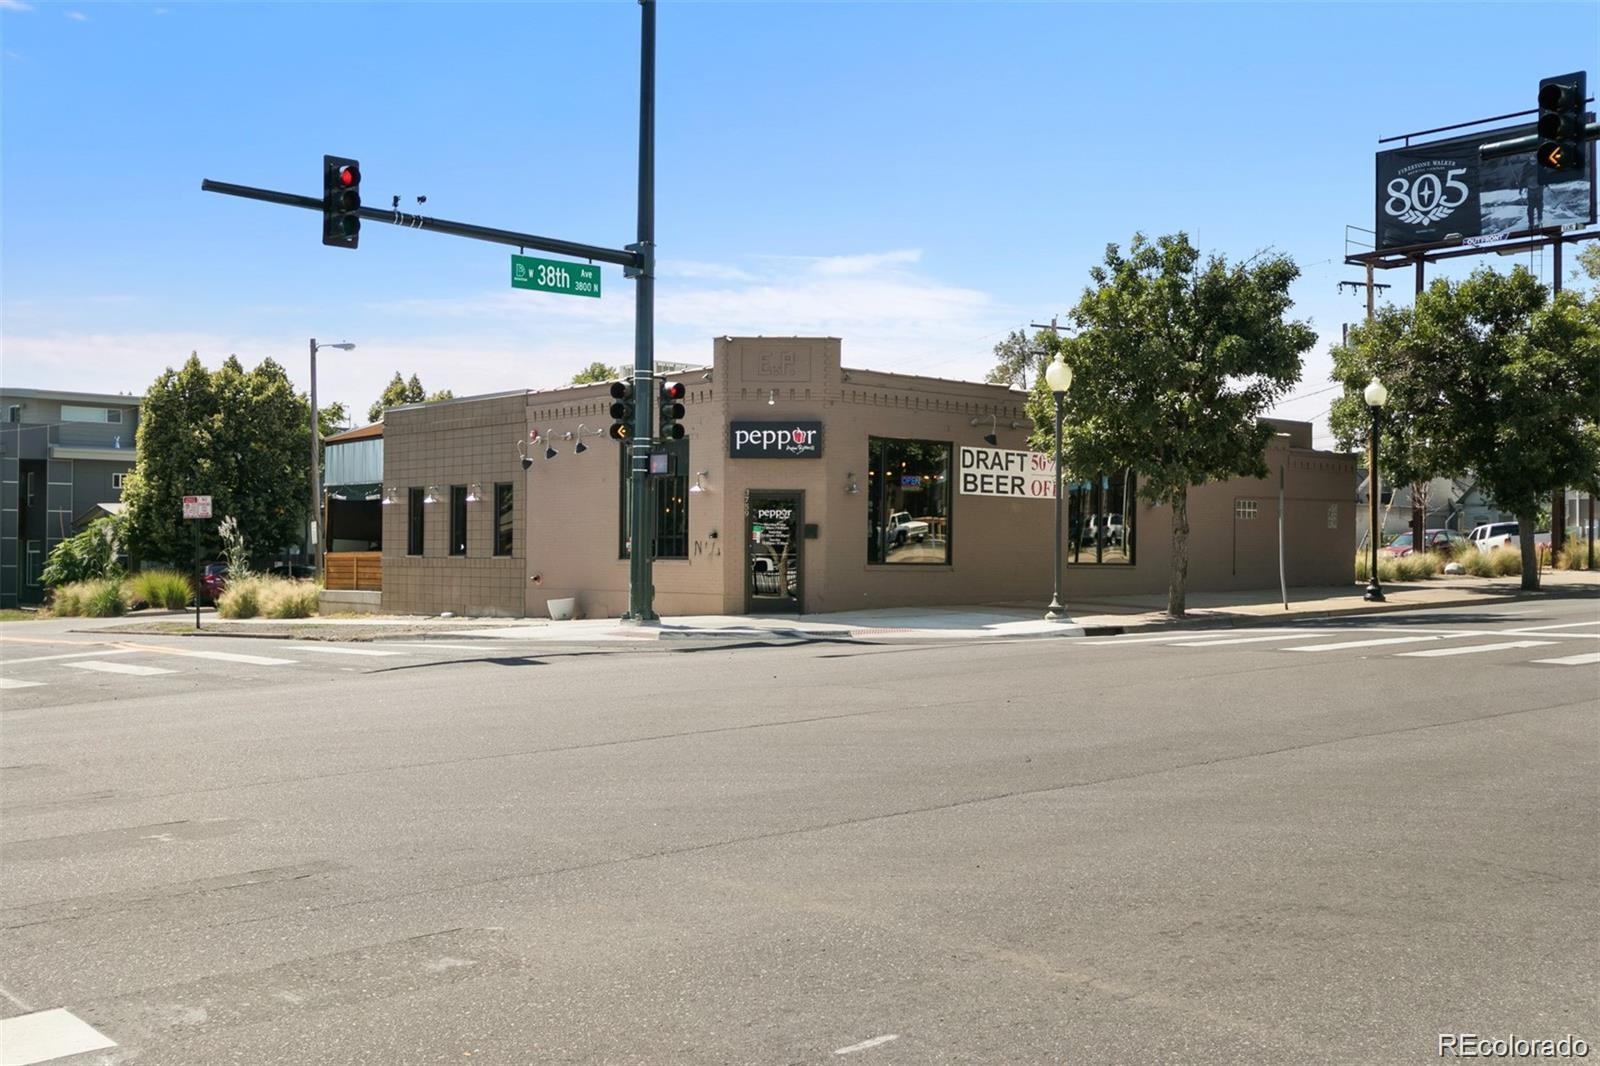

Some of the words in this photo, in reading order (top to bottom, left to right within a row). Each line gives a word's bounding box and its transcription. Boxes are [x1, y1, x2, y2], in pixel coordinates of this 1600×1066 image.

[1384, 167, 1469, 216] 805
[528, 268, 535, 278] W
[537, 264, 570, 289] 38th
[580, 269, 593, 279] Ave
[575, 281, 592, 293] 3800
[593, 283, 599, 292] N
[962, 448, 1028, 472] DRAFT
[963, 473, 1026, 496] BEER
